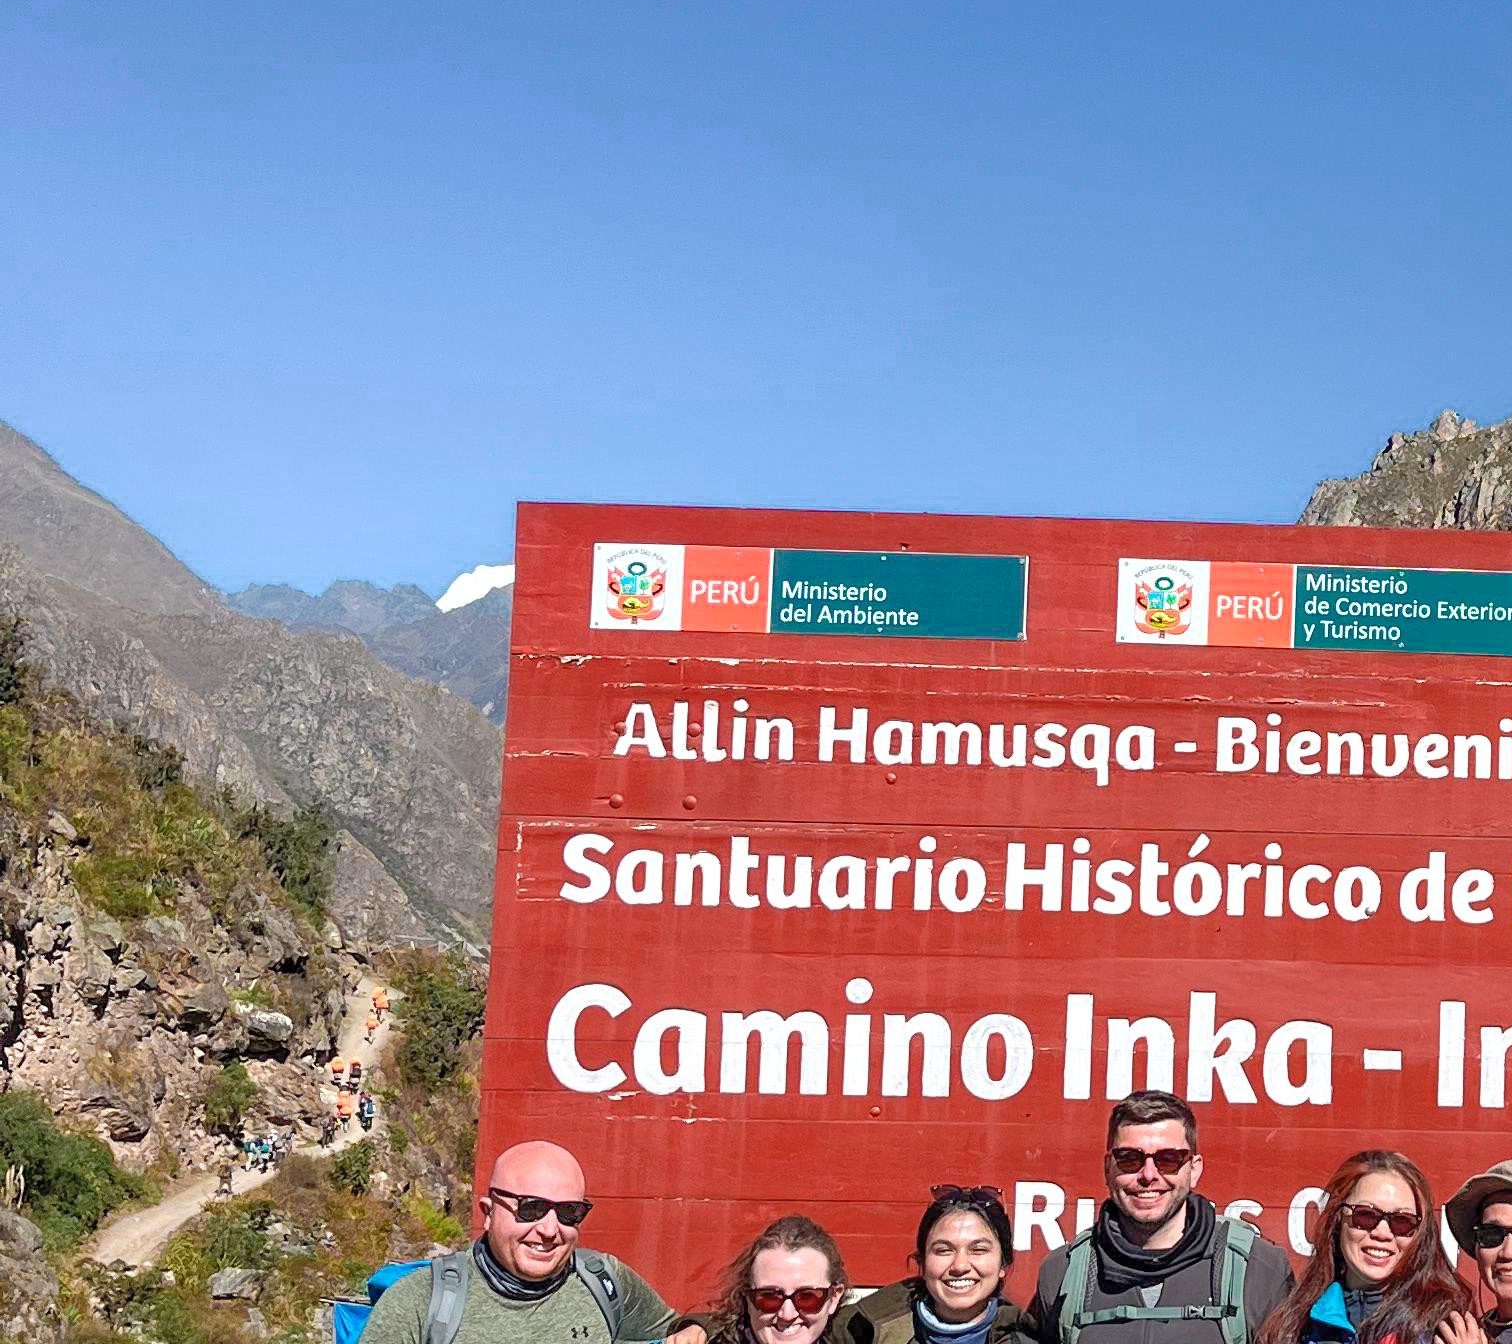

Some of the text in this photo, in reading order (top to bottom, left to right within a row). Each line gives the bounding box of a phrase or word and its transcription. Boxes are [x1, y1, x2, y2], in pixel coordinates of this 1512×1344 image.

[690, 576, 759, 605] PERÚ
[782, 580, 887, 602] Ministerio
[1306, 573, 1408, 595] Ministerio
[781, 603, 919, 627] del Ambiente
[1216, 591, 1284, 621] PERÚ
[1305, 598, 1330, 616] de
[1336, 600, 1430, 619] Comercio
[1304, 622, 1402, 643] y Turismo
[613, 699, 794, 764] Allin
[818, 707, 1156, 786] Hamusqa
[1174, 741, 1197, 753] -
[561, 833, 988, 912] Santuario
[1003, 834, 1383, 922] Histórico
[1399, 852, 1494, 924] de
[546, 978, 1034, 1101] Camino
[1063, 991, 1333, 1105] Inka
[1363, 1048, 1402, 1071] -
